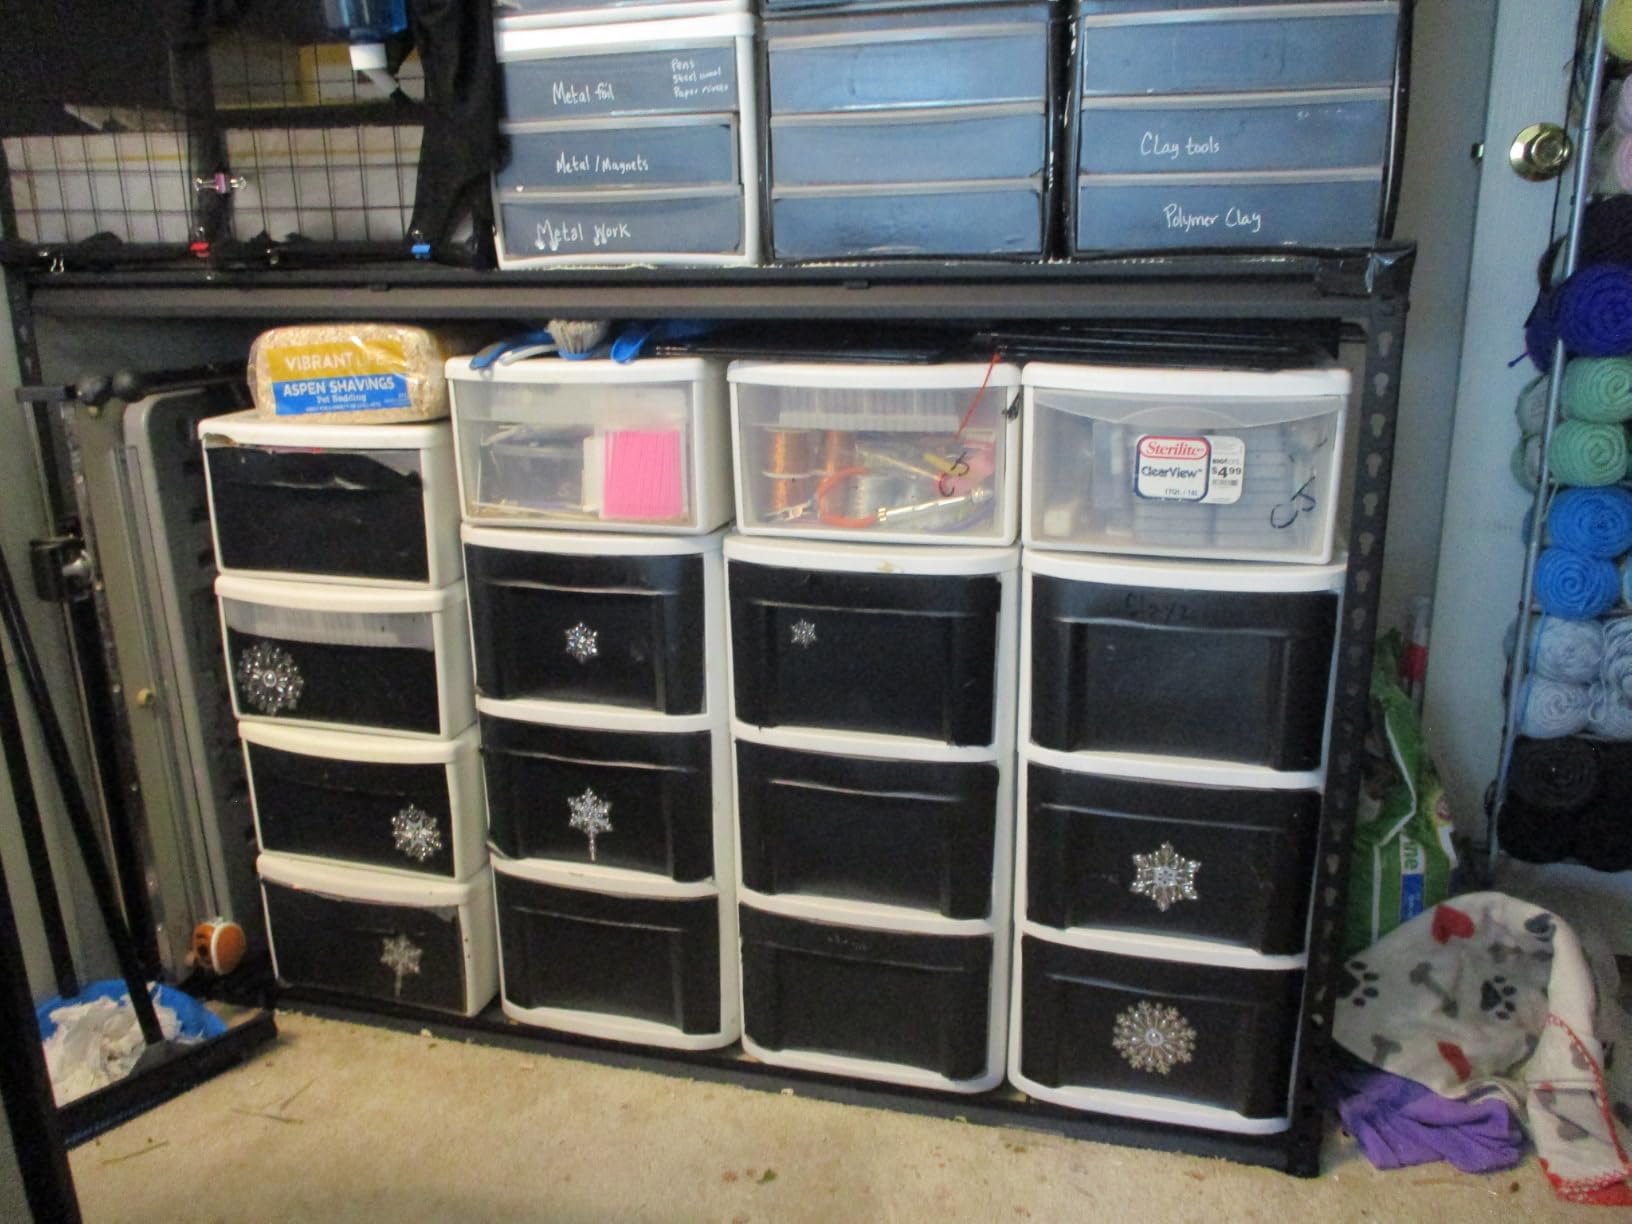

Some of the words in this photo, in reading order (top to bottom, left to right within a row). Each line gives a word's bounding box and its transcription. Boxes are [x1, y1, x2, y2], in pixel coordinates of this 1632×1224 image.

[552, 80, 591, 105] Metal
[594, 81, 615, 101] foil
[1185, 135, 1219, 155] tools
[1163, 203, 1219, 232] Polymer
[1225, 207, 1261, 233] Clay
[535, 219, 583, 251] Metal
[284, 351, 353, 371] VIBRANT
[283, 382, 326, 397] ASPEN
[330, 377, 395, 393] SHAVINGS
[1146, 441, 1200, 457] Sterilite
